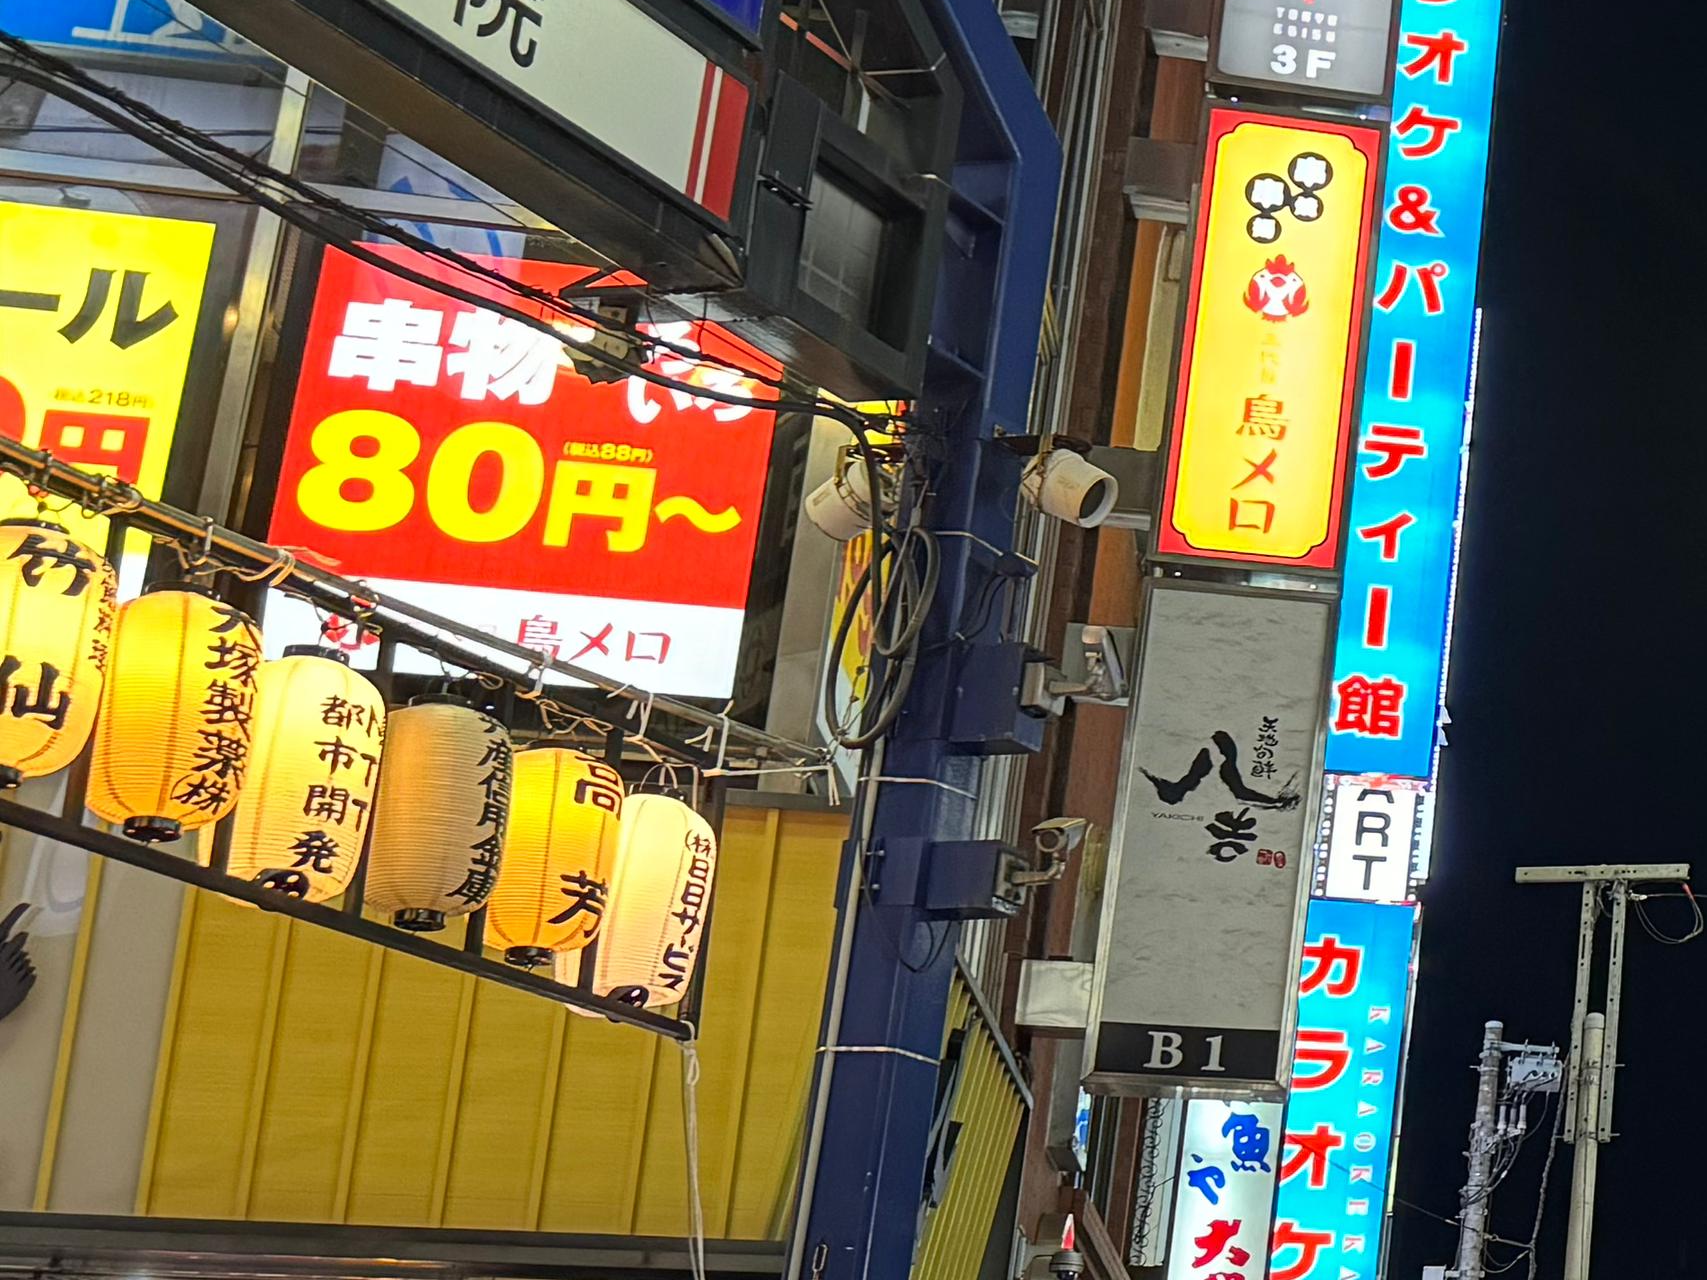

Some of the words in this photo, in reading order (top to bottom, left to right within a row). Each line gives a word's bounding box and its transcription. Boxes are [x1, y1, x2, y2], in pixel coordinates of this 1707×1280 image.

[1270, 45, 1336, 78] 3F
[1229, 393, 1291, 536] 鳥メロ
